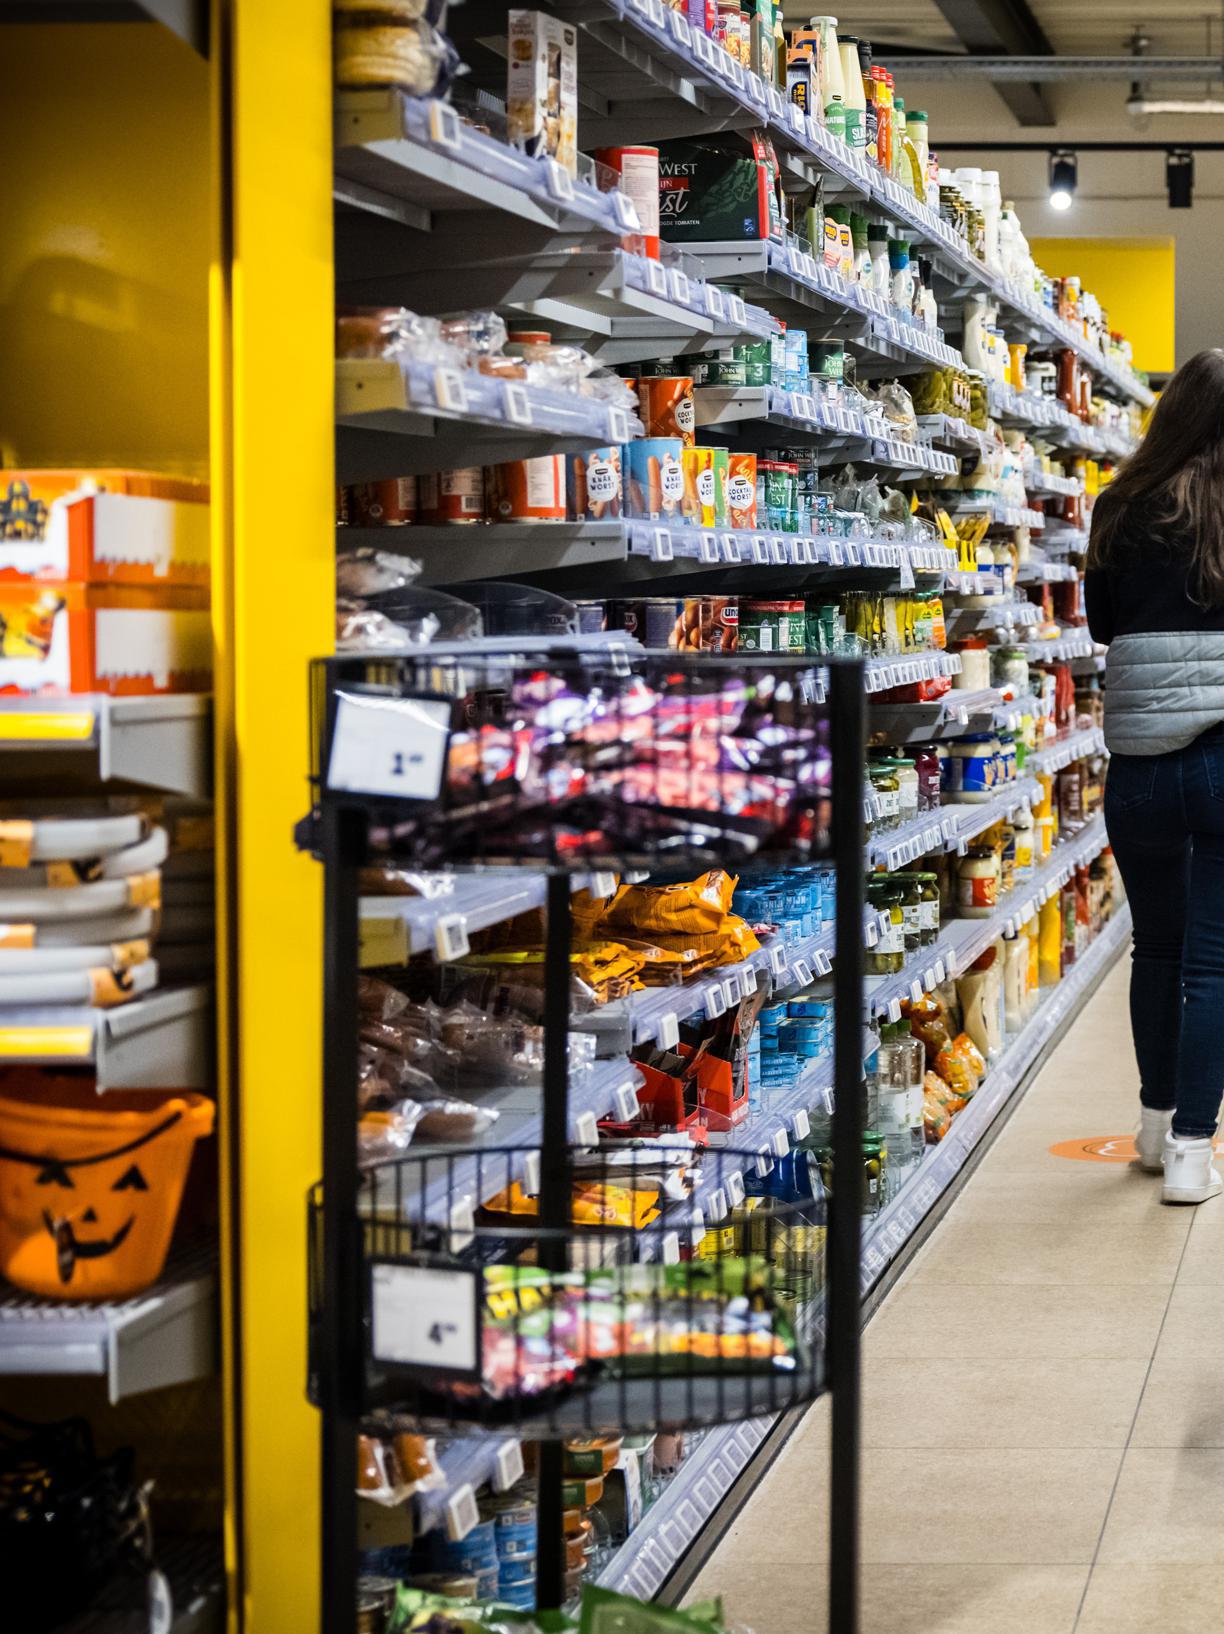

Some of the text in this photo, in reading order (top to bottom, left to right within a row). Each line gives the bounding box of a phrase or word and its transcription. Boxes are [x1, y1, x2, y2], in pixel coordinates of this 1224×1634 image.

[659, 163, 698, 176] WEST
[660, 180, 673, 189] IJN
[659, 187, 690, 214] ist
[771, 494, 786, 505] EST
[788, 635, 802, 645] EST
